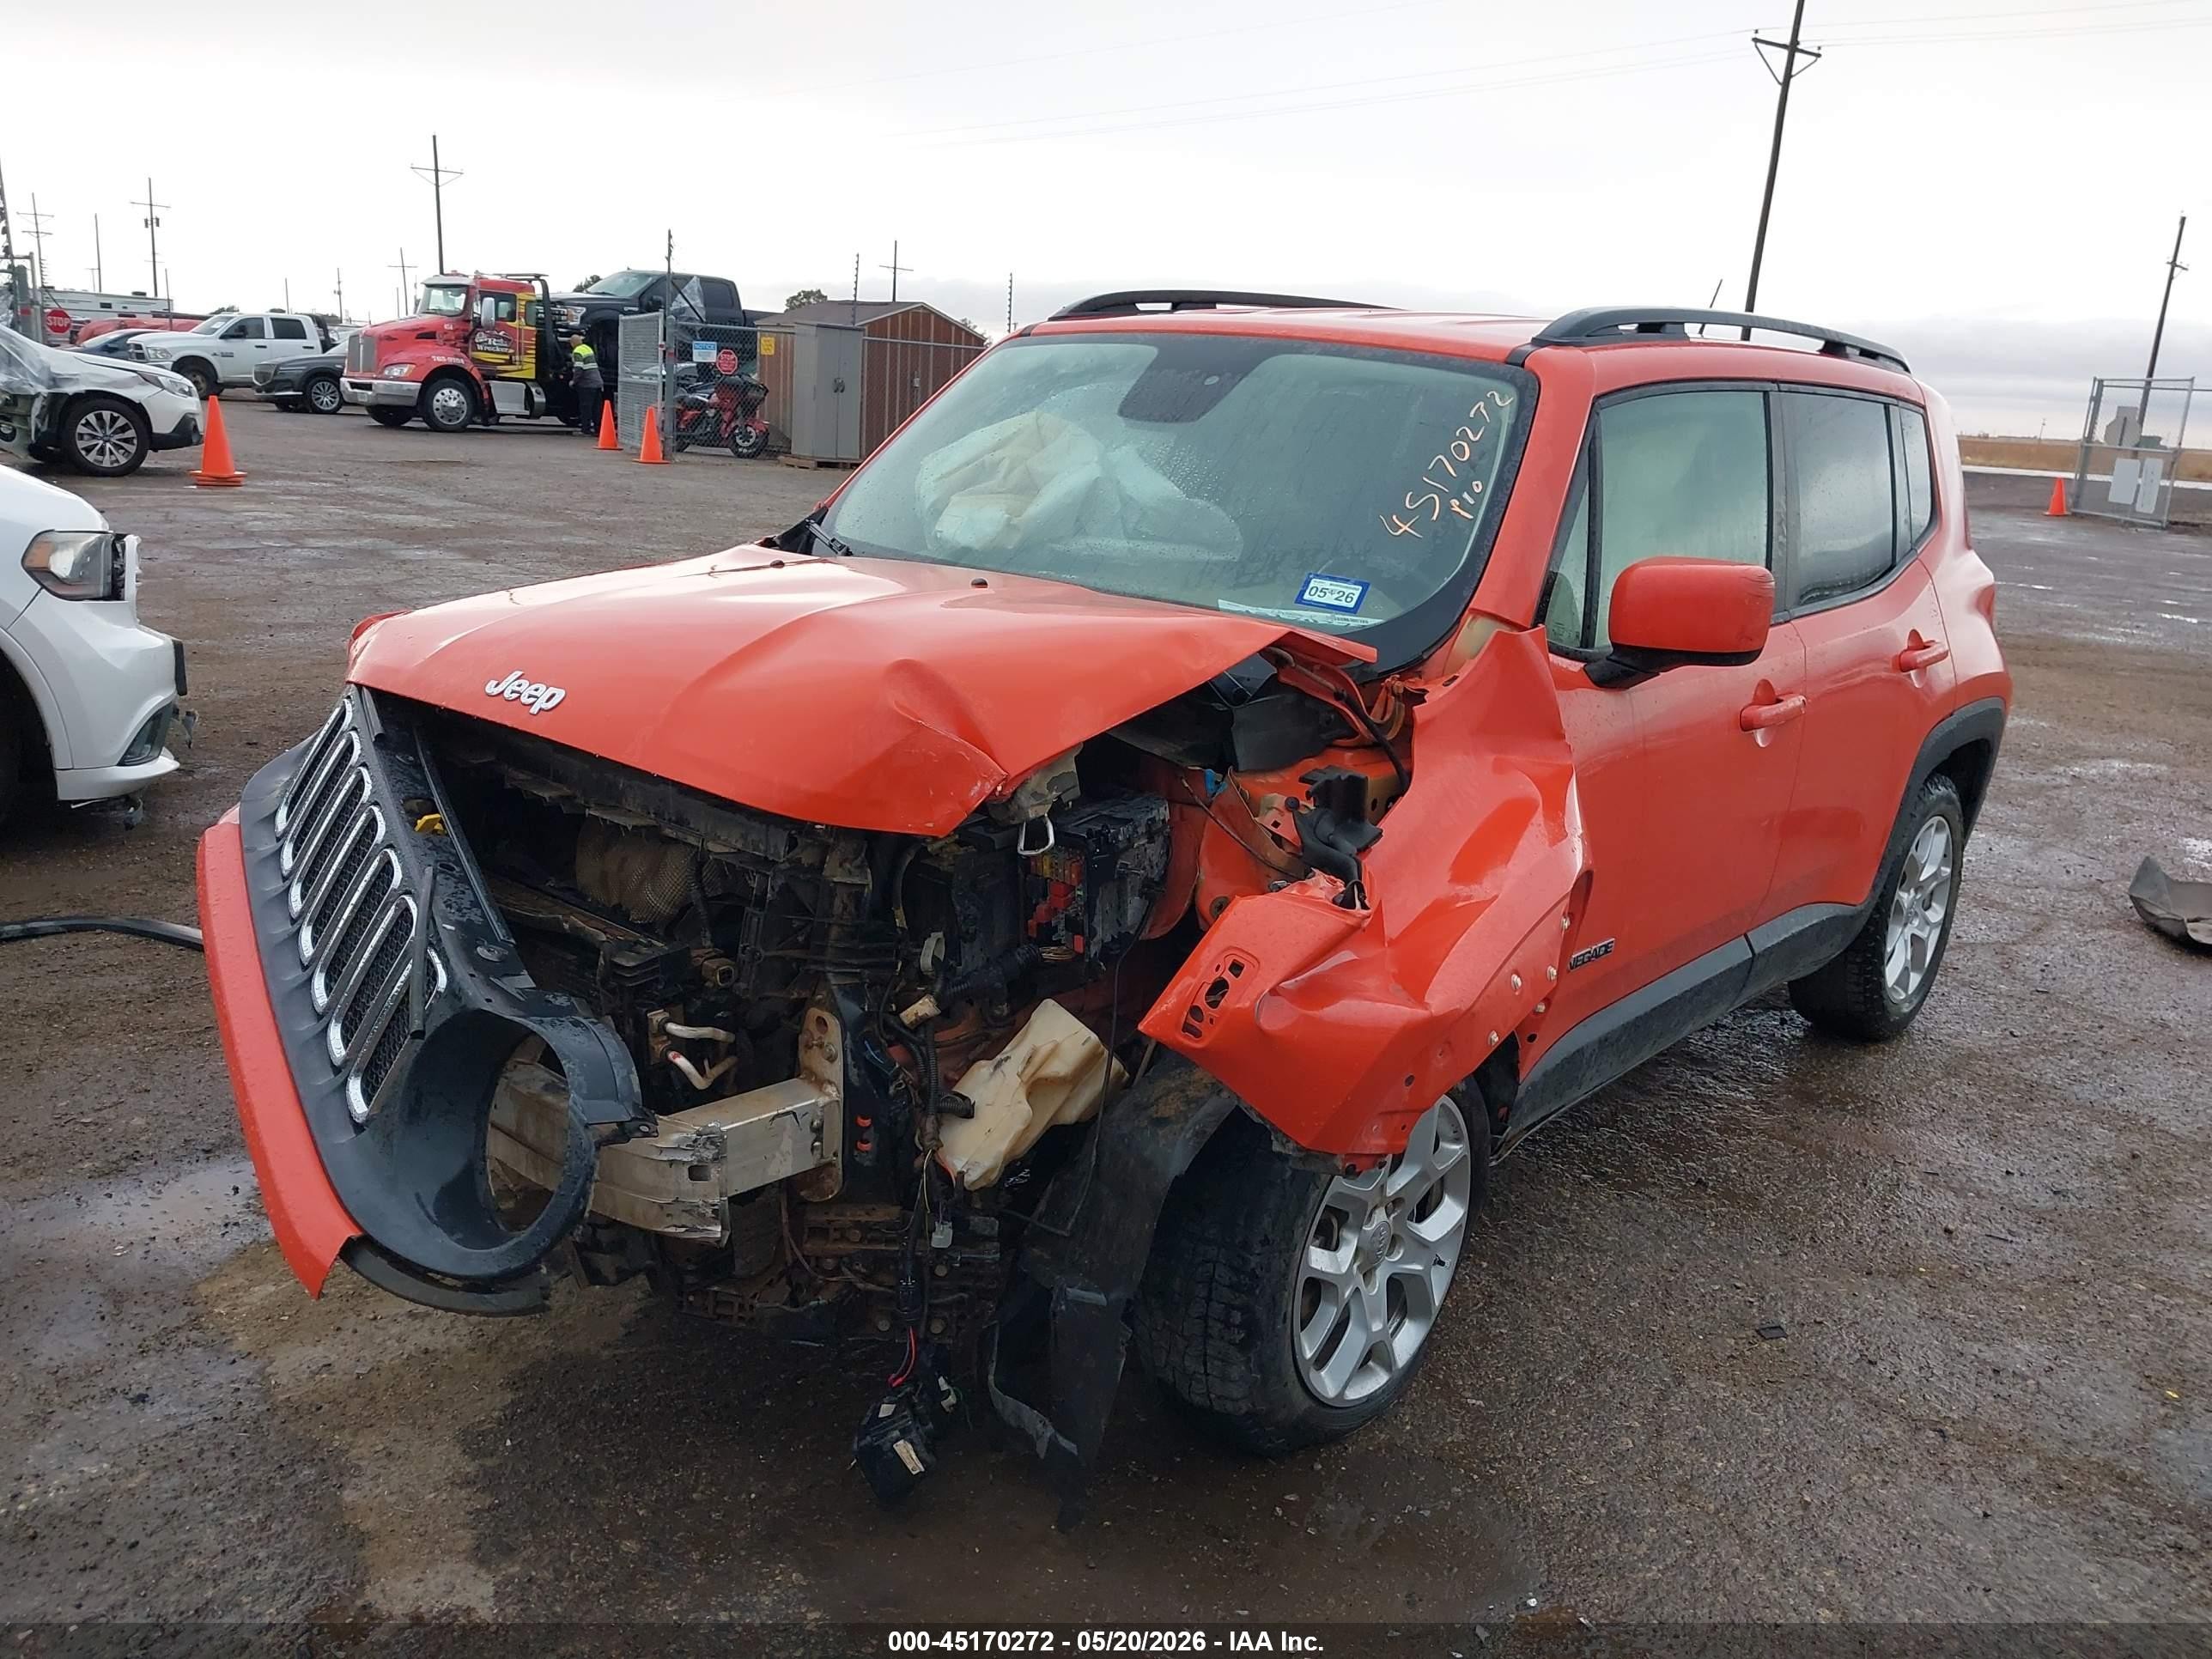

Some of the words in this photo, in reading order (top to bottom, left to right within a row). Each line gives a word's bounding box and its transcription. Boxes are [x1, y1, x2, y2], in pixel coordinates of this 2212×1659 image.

[47, 316, 70, 328] STOP
[1379, 391, 1515, 539] 45170272
[1308, 586, 1329, 599] 05
[1334, 590, 1356, 604] 26
[484, 669, 567, 716] Jeep
